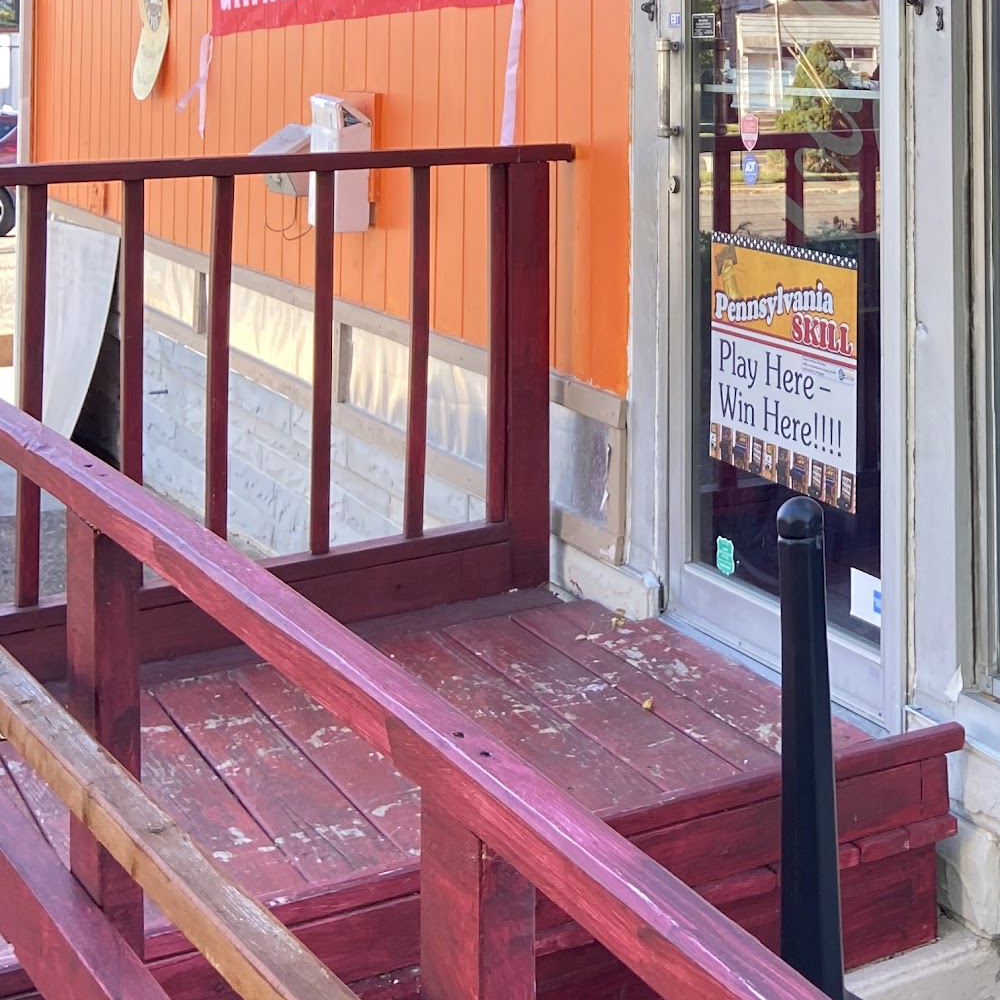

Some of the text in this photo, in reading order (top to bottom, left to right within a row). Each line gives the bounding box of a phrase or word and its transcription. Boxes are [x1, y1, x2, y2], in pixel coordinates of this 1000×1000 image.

[745, 161, 756, 173] ADT
[714, 281, 834, 326] Pennsylvania
[791, 312, 853, 356] SKILL
[719, 338, 758, 389] Play
[765, 351, 814, 400] Here
[719, 382, 842, 457] Win Here!!!!
